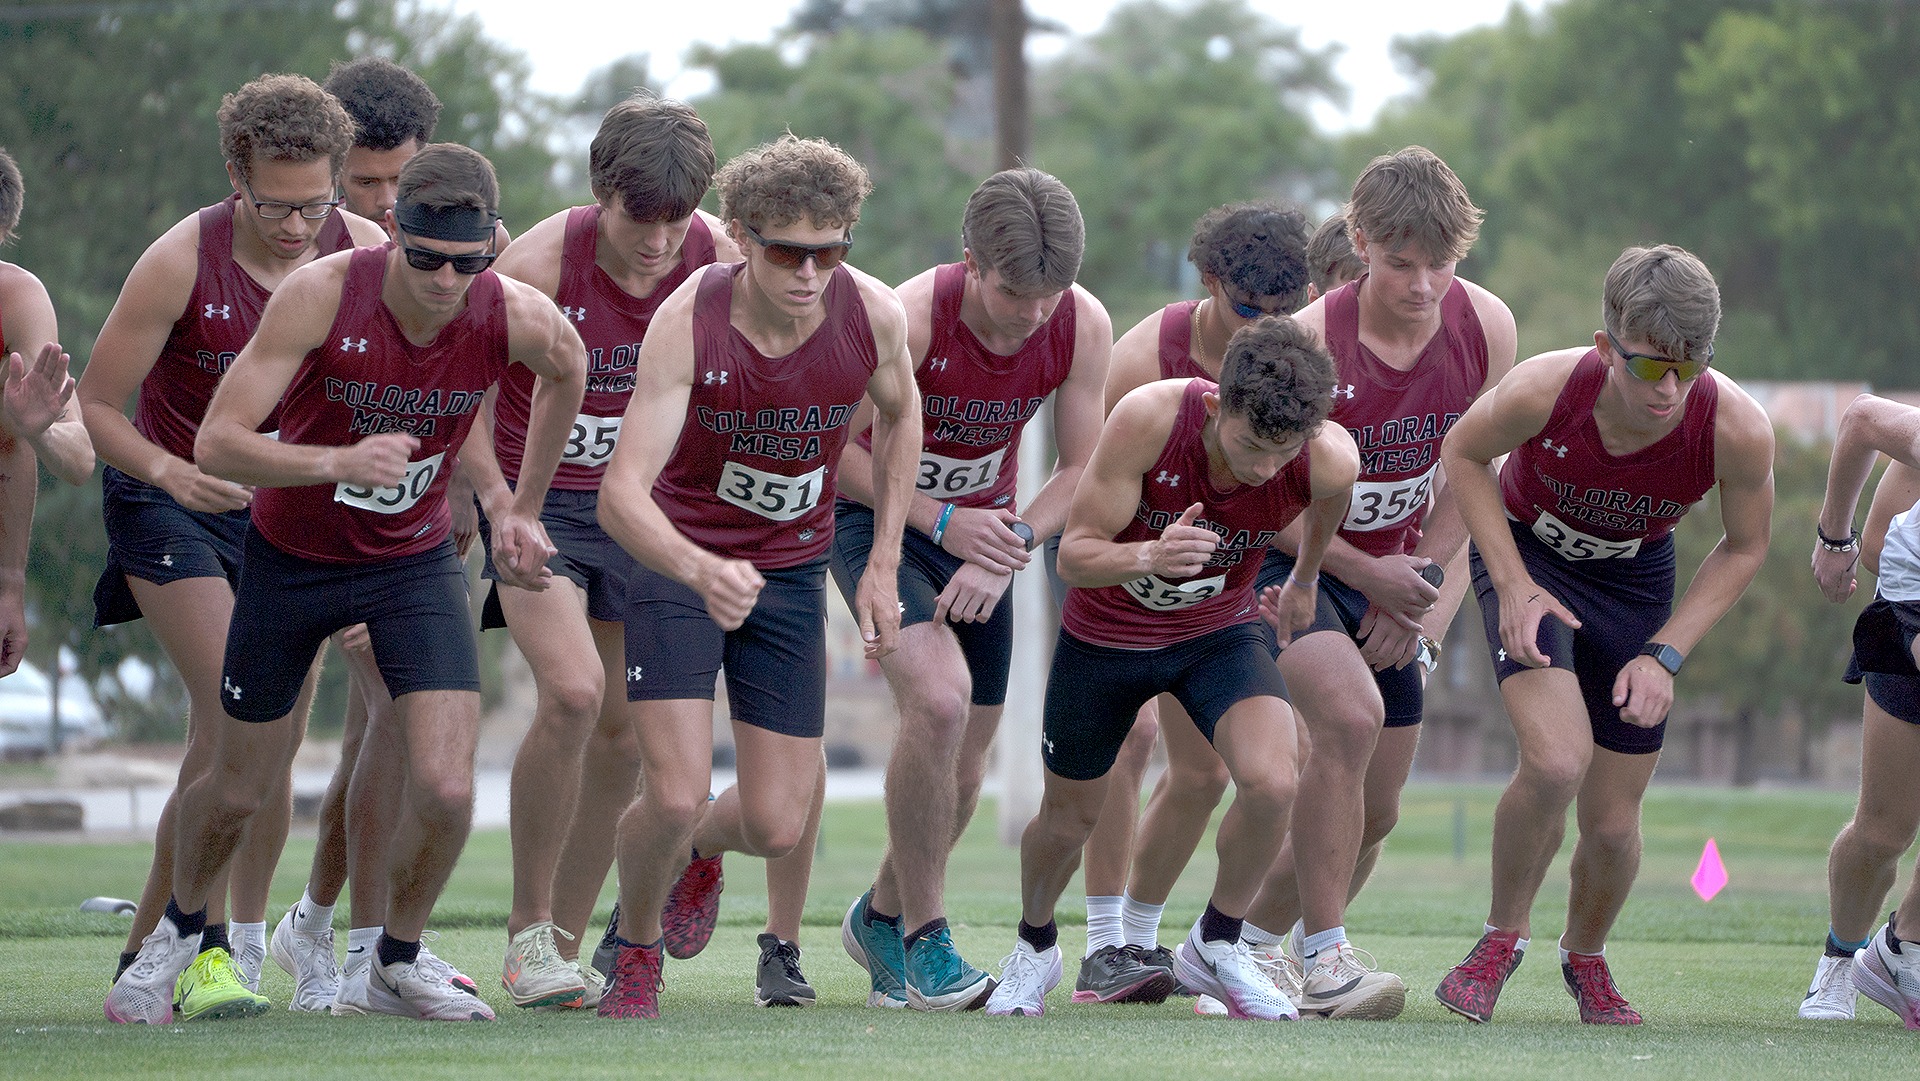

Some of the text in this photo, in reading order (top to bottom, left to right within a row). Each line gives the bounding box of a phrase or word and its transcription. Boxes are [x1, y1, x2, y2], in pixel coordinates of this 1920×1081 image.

[349, 408, 435, 437] MESA
[921, 395, 1049, 423] OLORAD
[562, 423, 619, 459] 35
[730, 433, 821, 461] MESA
[933, 420, 1014, 446] MESA
[1359, 443, 1432, 475] MESA
[725, 470, 812, 513] 351
[916, 459, 992, 492] 361
[1353, 476, 1430, 525] 358
[1555, 496, 1648, 531] MESA
[1537, 522, 1633, 559] 357
[1128, 577, 1216, 607] 353
